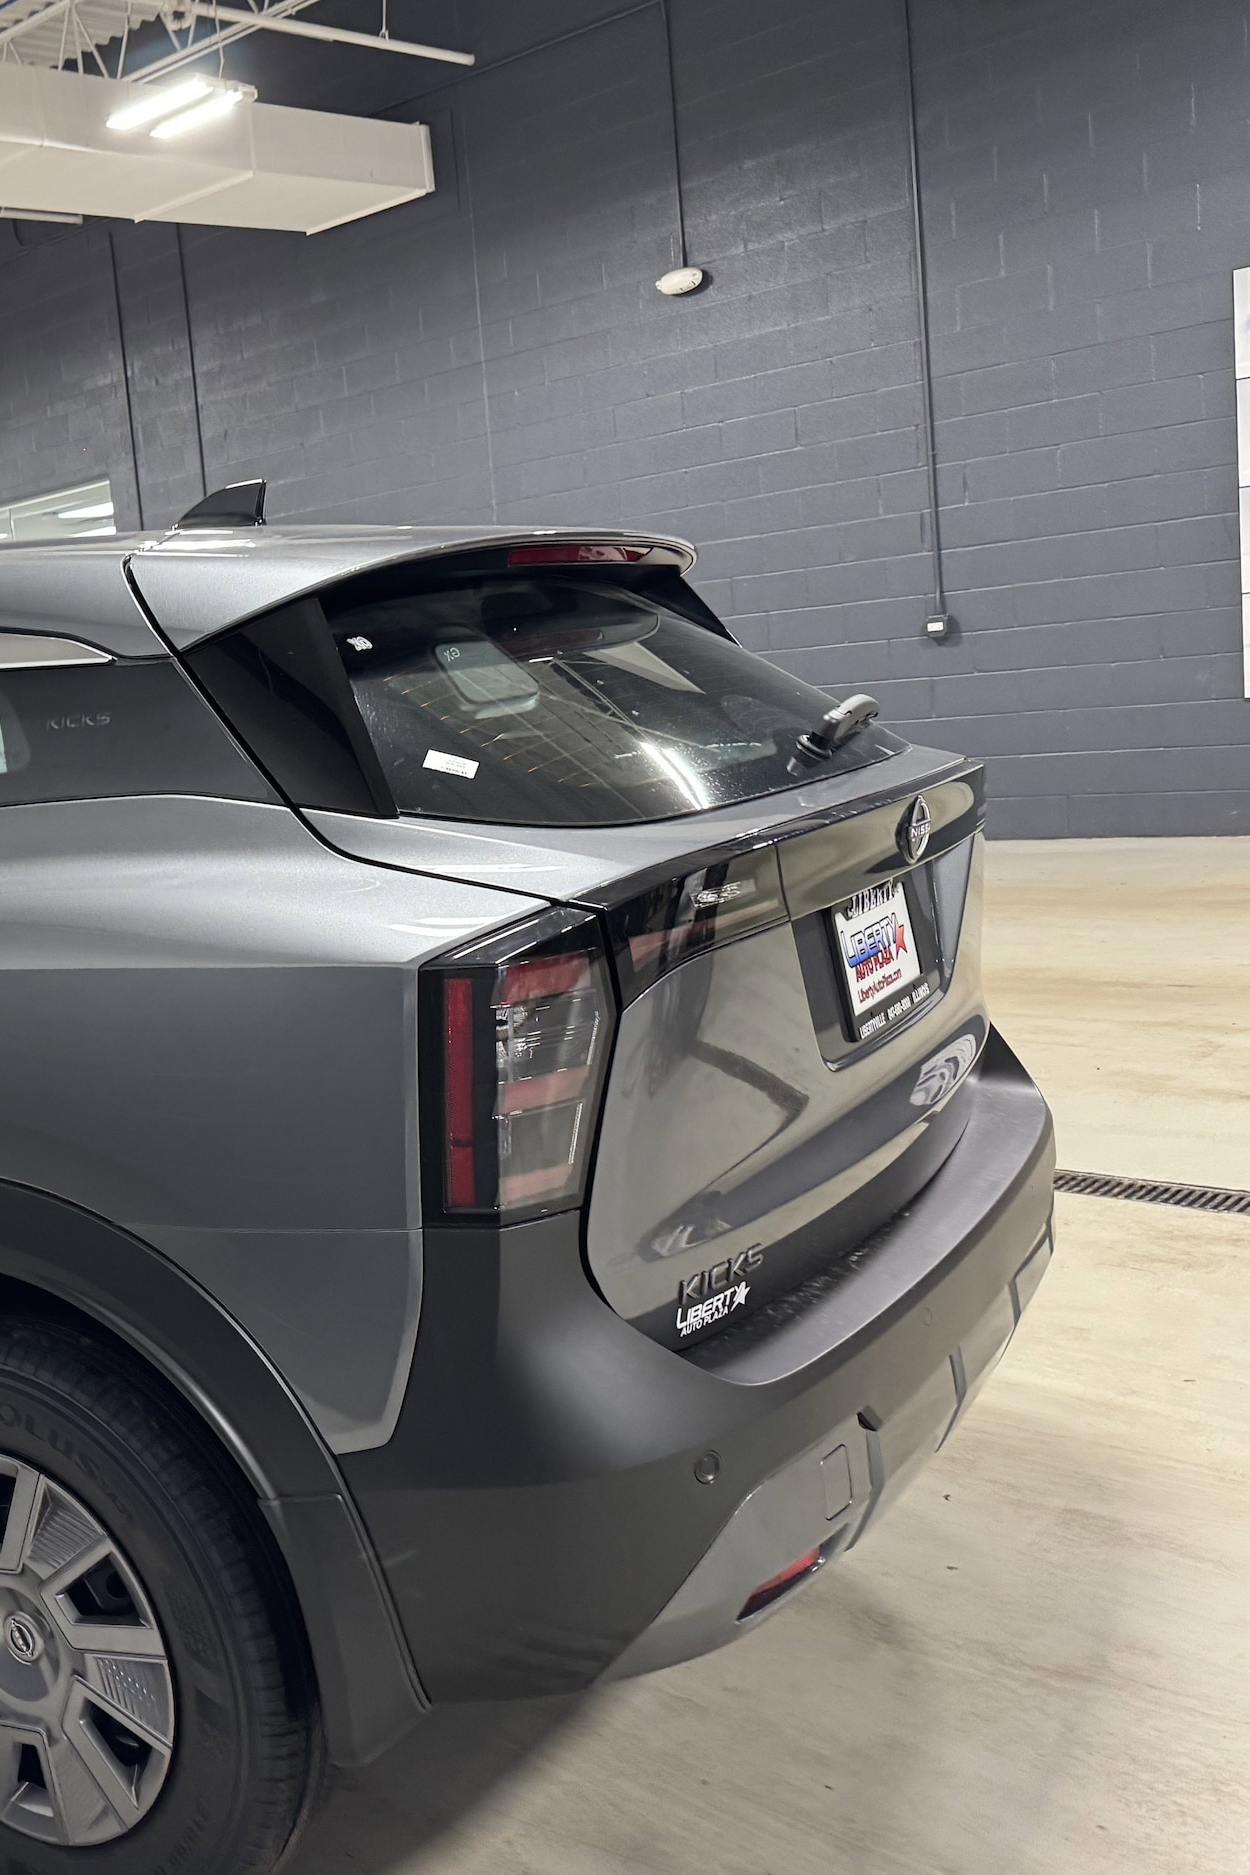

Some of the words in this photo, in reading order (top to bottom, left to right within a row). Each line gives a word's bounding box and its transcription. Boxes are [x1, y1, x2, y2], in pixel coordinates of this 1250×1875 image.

[46, 711, 112, 732] KICKS
[910, 822, 931, 838] NISS
[840, 912, 898, 969] LIBERTY
[854, 955, 875, 983] AUTO
[859, 1012, 887, 1040] LIBERTYVILLE
[677, 1243, 764, 1305] KICKS
[676, 1281, 746, 1330] LIBERTY
[680, 1320, 703, 1338] AUTO
[703, 1304, 729, 1328] PLAZA
